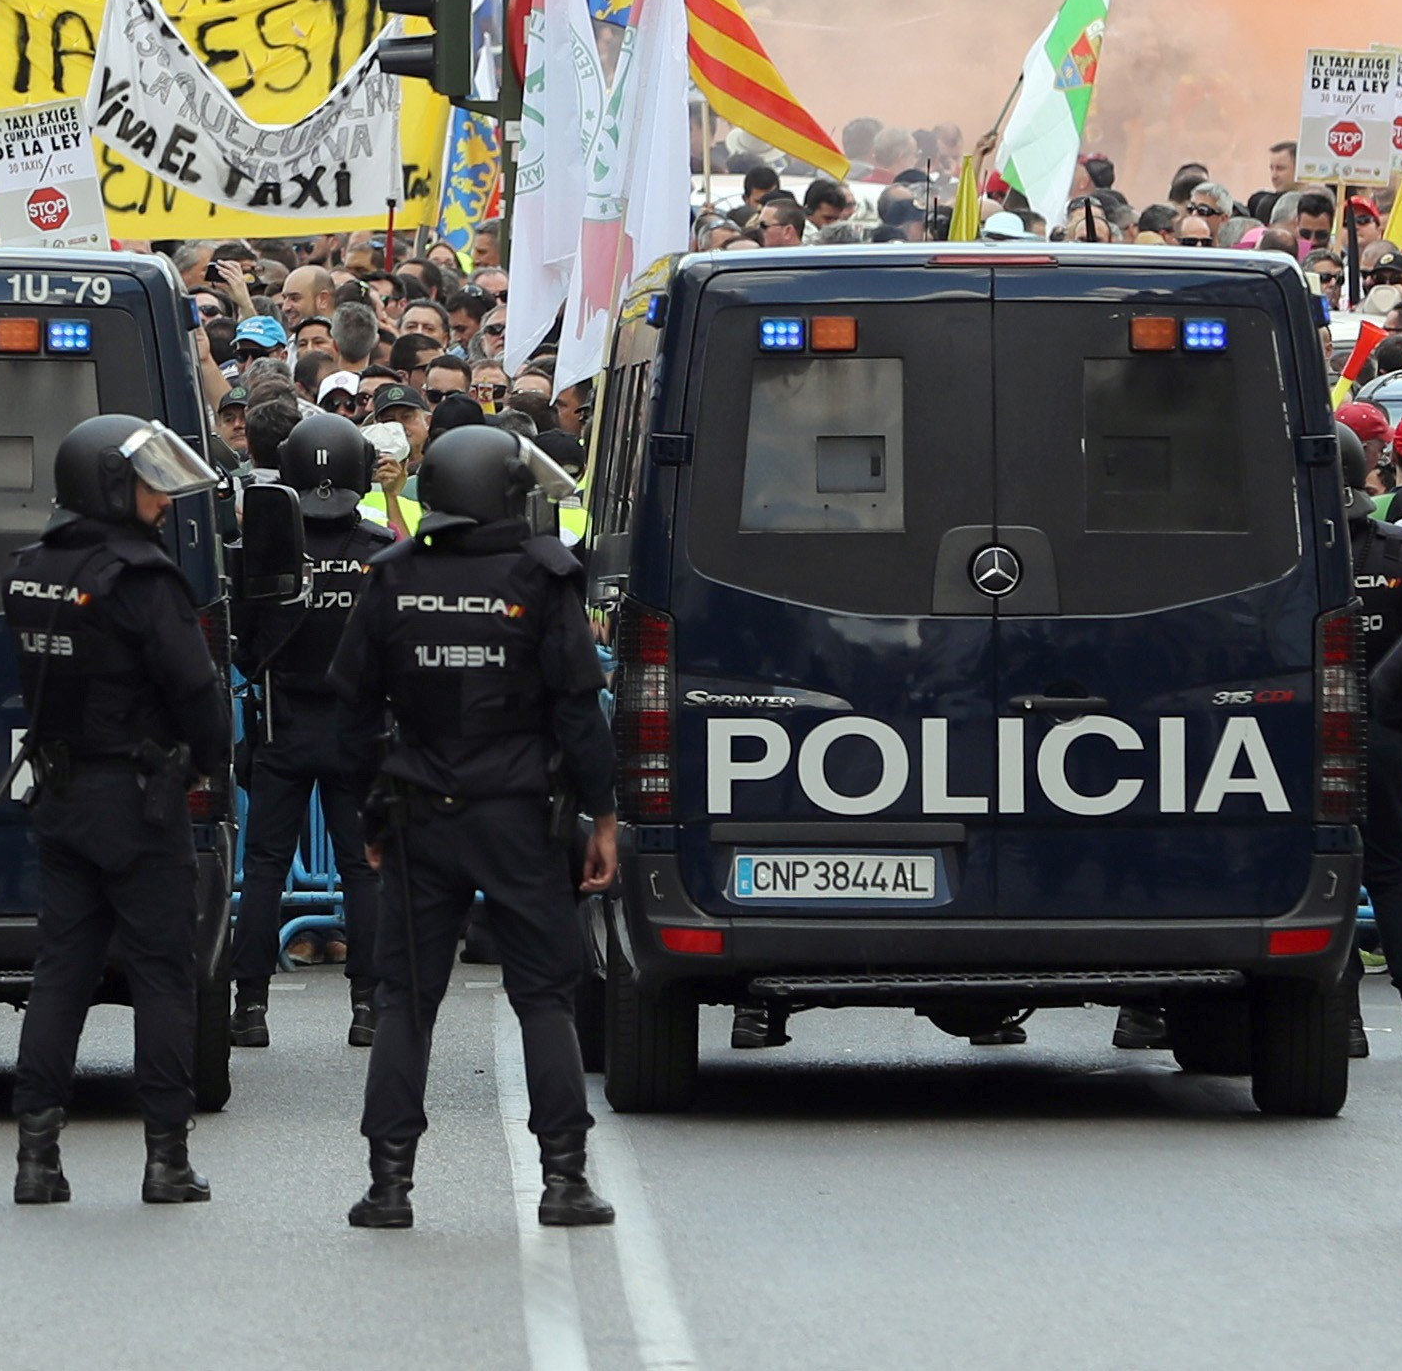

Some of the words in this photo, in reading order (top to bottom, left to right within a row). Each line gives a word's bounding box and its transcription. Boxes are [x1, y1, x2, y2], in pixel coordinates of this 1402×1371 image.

[1313, 55, 1324, 66] EL
[1329, 56, 1354, 67] TAXI
[1359, 58, 1391, 70] EXIGE
[1312, 67, 1321, 76] EL
[1324, 68, 1390, 80] CUMPLIMIENTO
[1311, 77, 1330, 90] DE
[1337, 79, 1356, 92] LA
[1362, 80, 1389, 94] LEY
[5, 115, 34, 132] TAXI
[38, 106, 77, 126] EXIGE
[4, 122, 79, 143] CUMPLIMIENTO
[1330, 131, 1362, 145] STOP
[22, 139, 43, 157] LA
[51, 132, 82, 152] LEY
[9, 163, 19, 174] 30
[21, 159, 44, 171] TAXIS
[57, 163, 75, 176] VTC
[28, 198, 66, 218] STOP
[40, 214, 58, 225] VTC
[6, 273, 112, 306] 1U-79
[397, 594, 509, 616] POLICIA
[1211, 689, 1253, 706] 315
[707, 715, 1292, 816] POLICIA
